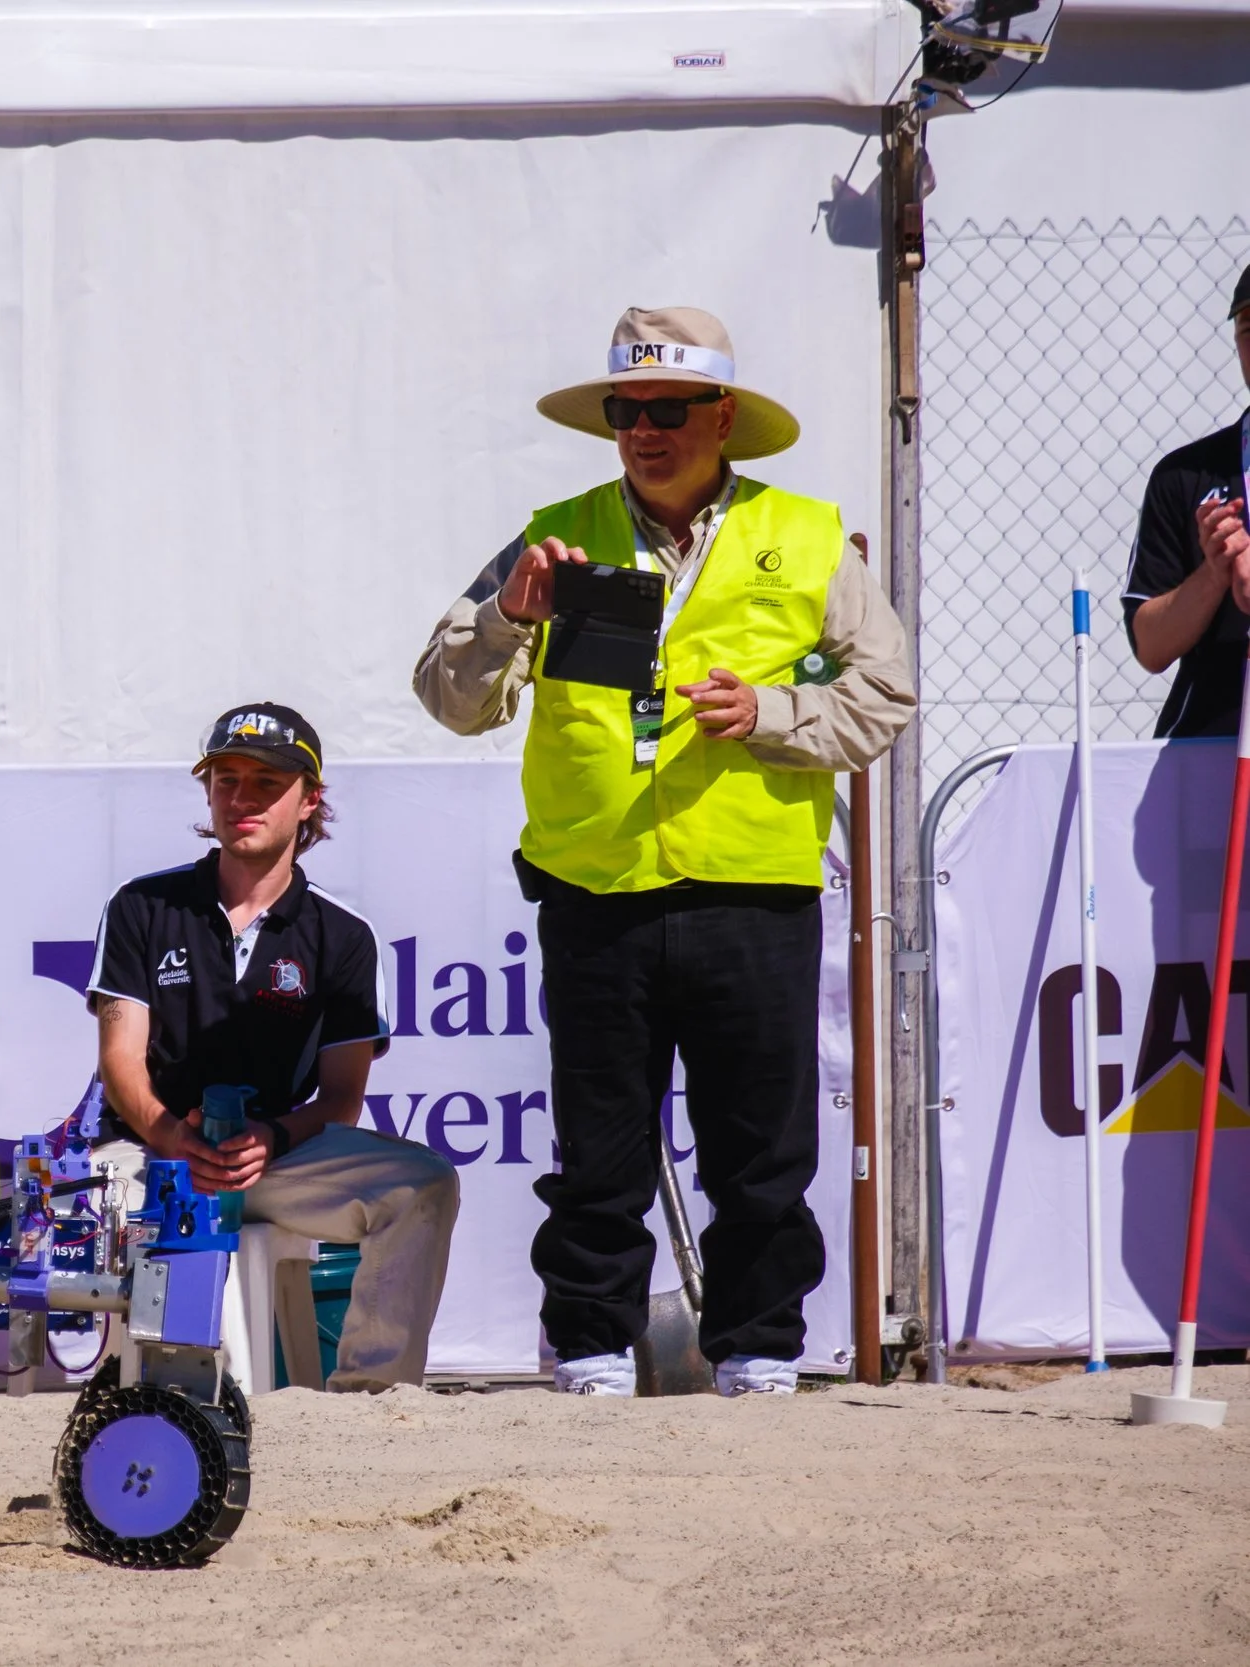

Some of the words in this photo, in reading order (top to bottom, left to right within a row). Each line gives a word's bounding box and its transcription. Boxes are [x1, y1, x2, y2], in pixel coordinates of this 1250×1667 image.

[675, 58, 722, 66] ROBIAN
[632, 344, 665, 365] CAT
[227, 713, 273, 735] CAT
[1039, 959, 1250, 1138] CA
